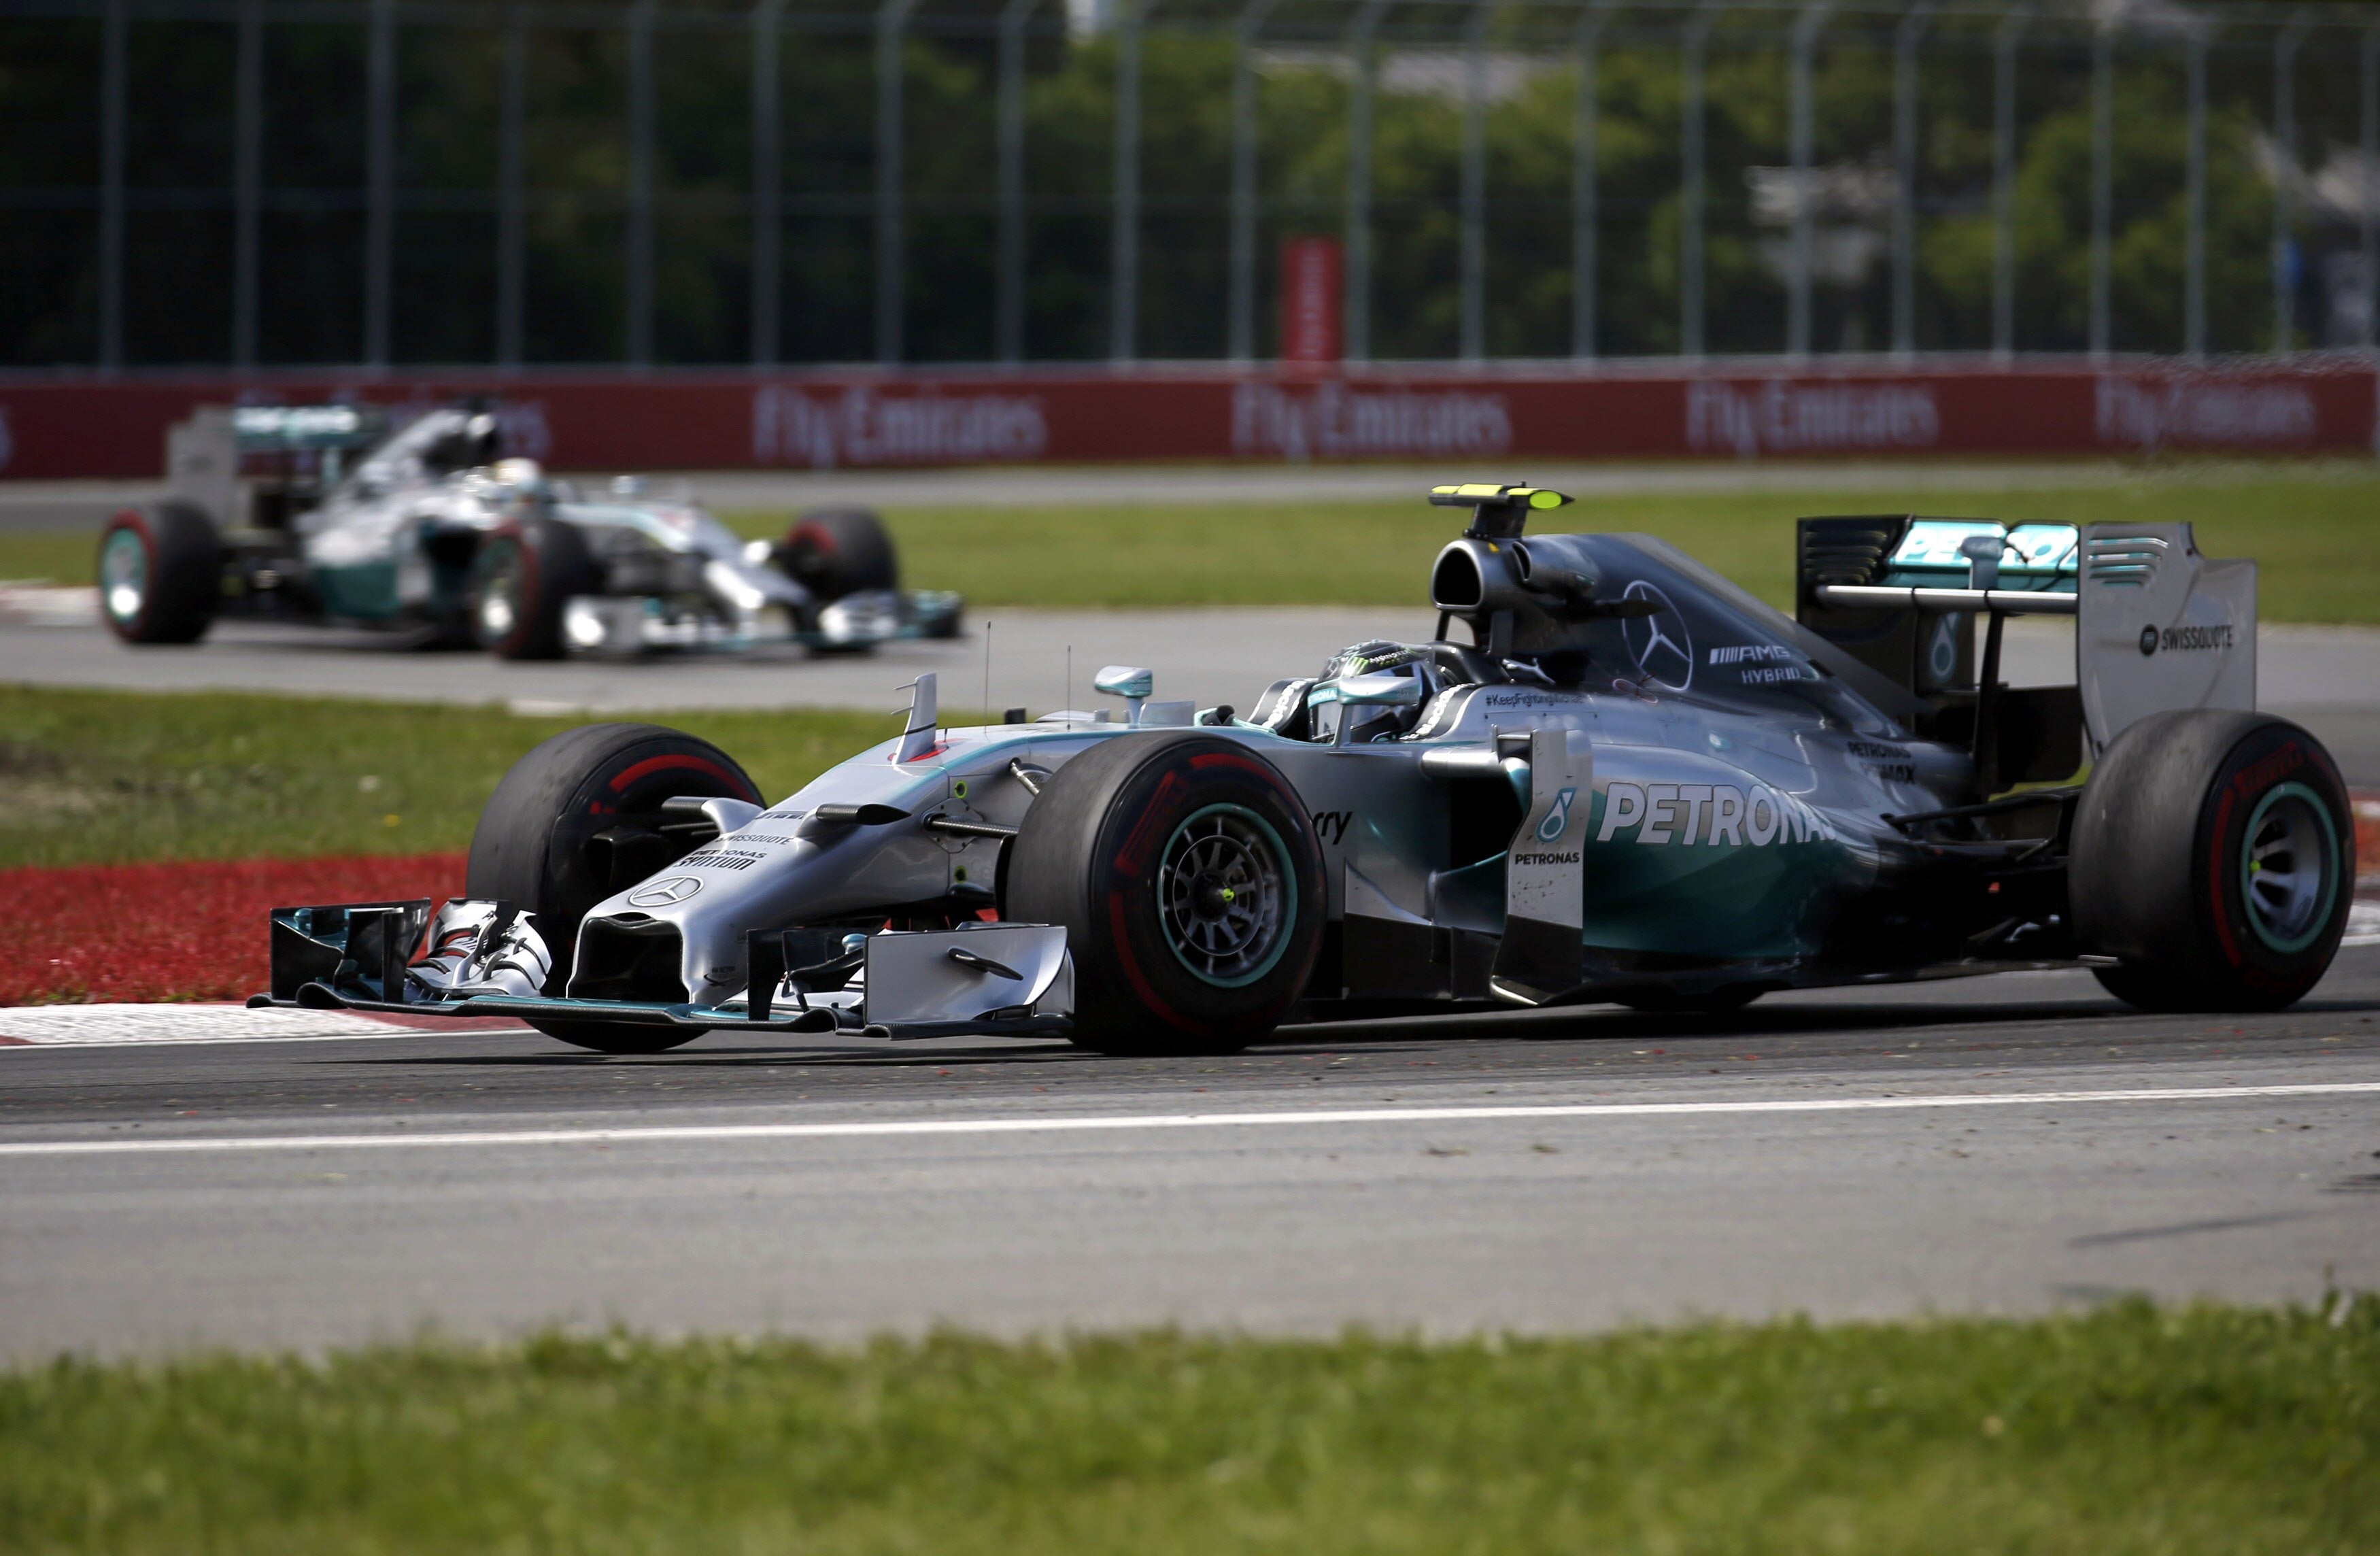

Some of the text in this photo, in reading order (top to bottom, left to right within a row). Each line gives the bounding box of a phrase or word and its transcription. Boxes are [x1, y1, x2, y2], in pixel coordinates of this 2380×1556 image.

[2162, 624, 2233, 650] SWISSQUOTE
[1738, 645, 1791, 662] AMG
[1514, 852, 1580, 865] PETRONAS
